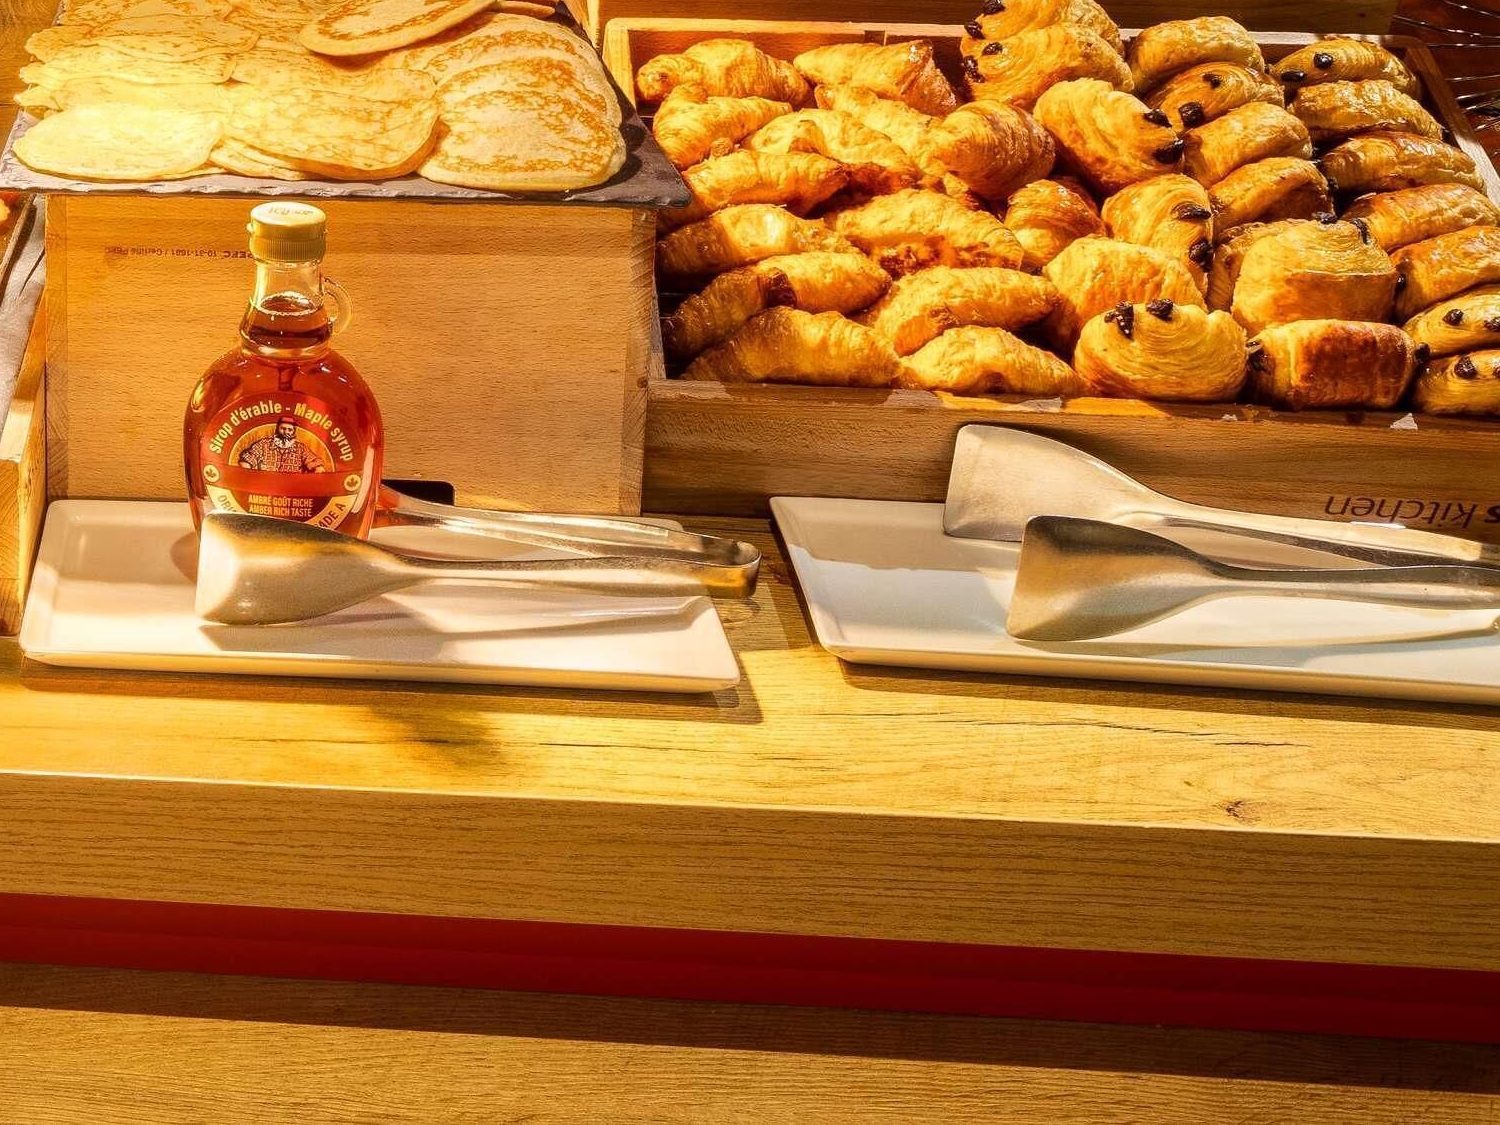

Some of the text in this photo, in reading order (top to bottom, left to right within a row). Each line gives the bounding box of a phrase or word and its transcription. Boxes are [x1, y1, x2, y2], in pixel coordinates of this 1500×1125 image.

[209, 422, 234, 454] Sirop
[230, 400, 282, 427] d'érable
[294, 403, 333, 430] Maple
[330, 427, 353, 461] syrup
[248, 494, 313, 508] AMBRÉ GOÛT RICHE
[248, 504, 312, 517] AMBER RICH TASTE
[1325, 496, 1478, 528] kitchen
